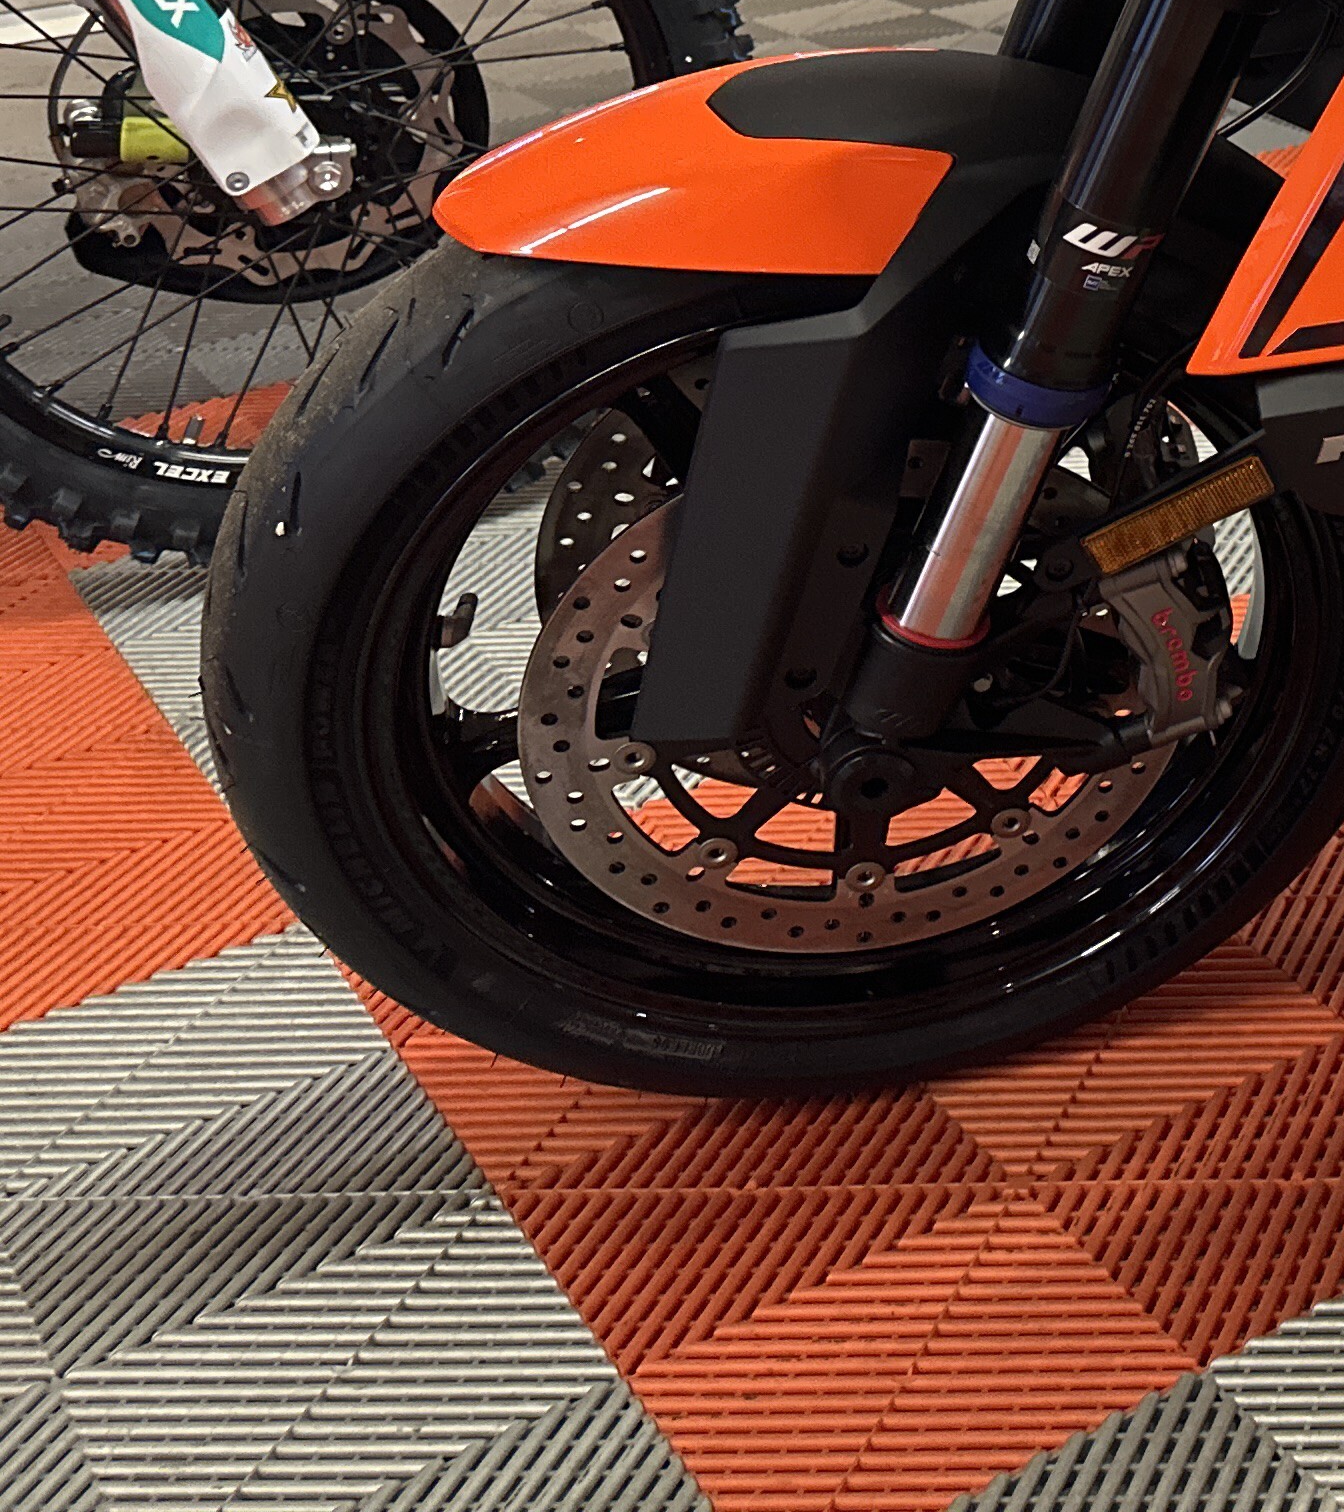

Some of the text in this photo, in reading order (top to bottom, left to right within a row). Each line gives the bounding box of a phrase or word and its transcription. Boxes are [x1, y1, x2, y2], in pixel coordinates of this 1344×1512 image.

[1081, 262, 1133, 278] APEX
[154, 461, 231, 484] EXCEL
[1151, 607, 1198, 702] brembo
